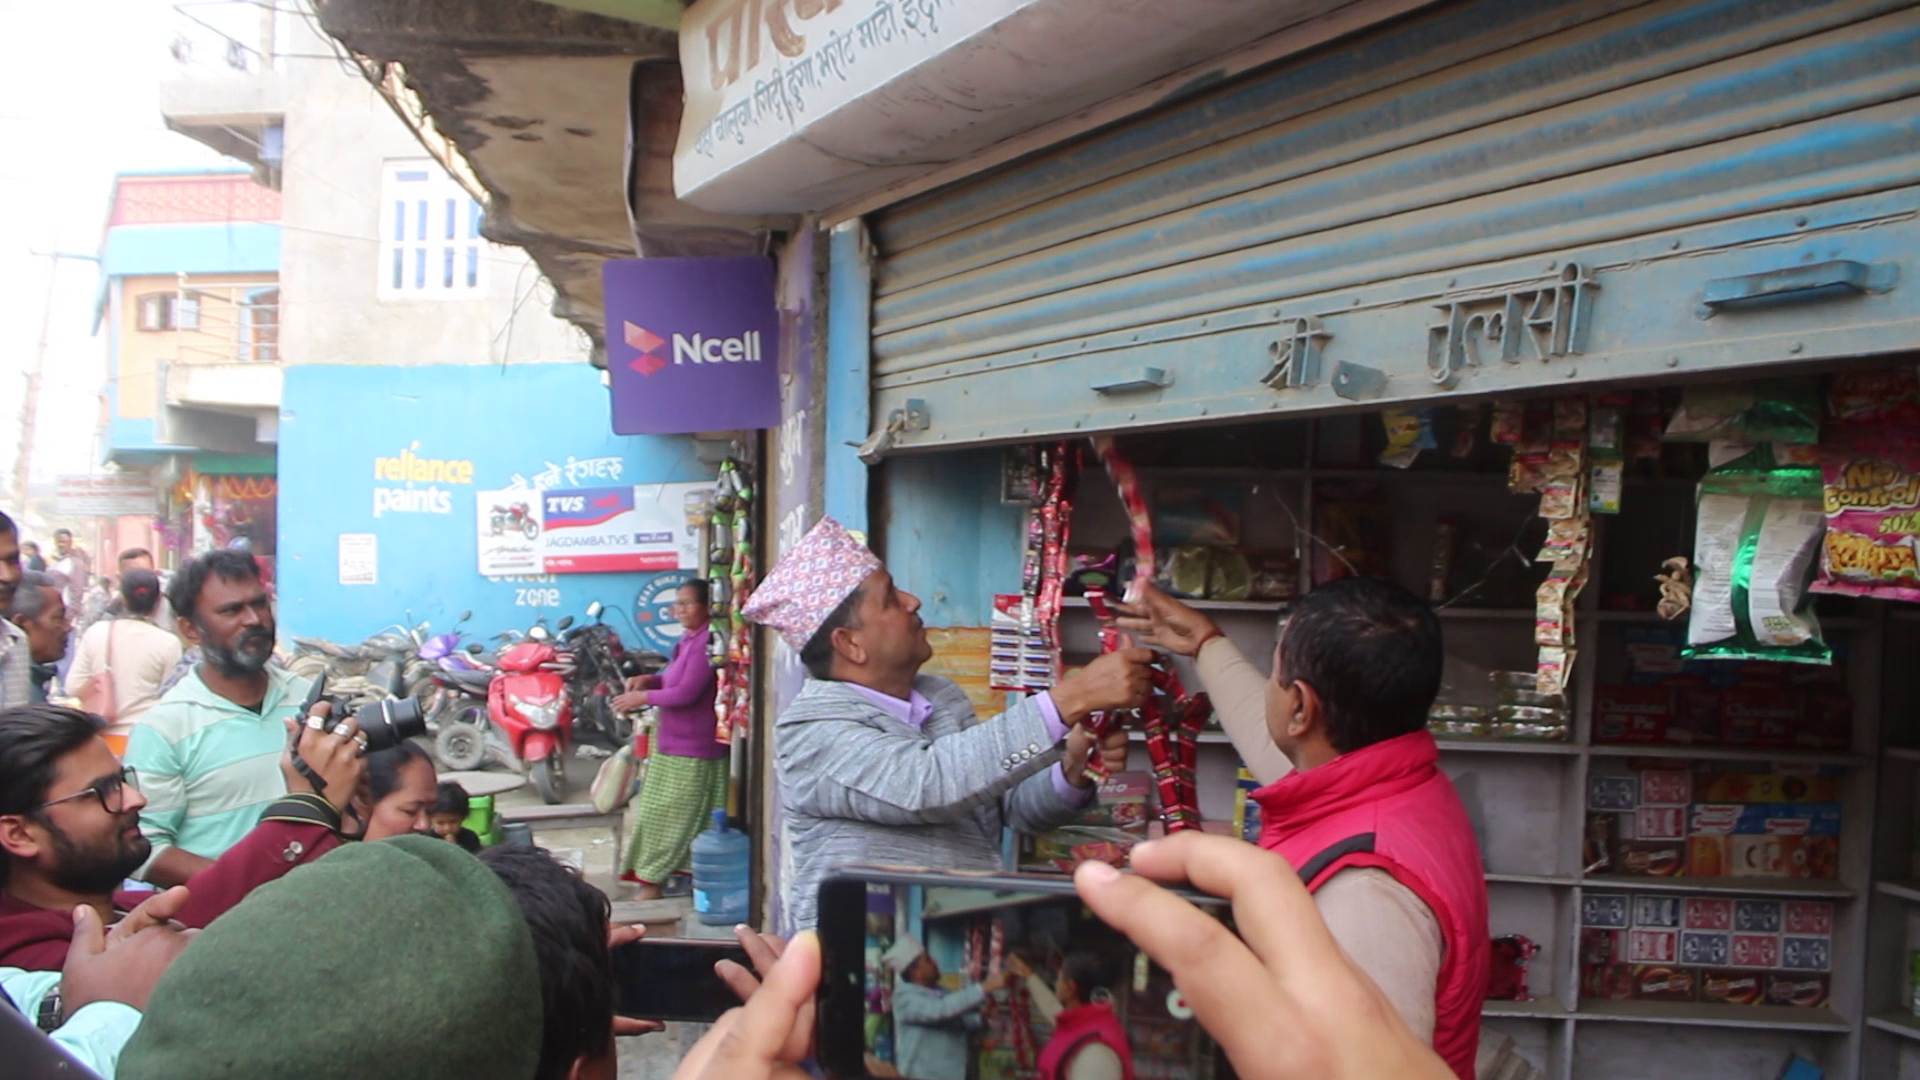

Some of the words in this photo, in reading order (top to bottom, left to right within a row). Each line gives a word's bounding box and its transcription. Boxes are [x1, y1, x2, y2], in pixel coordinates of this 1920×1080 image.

[1260, 315, 1335, 389] श्री
[1426, 261, 1601, 391] तुलसी
[672, 330, 761, 365] Ncell
[374, 439, 474, 485] reliance
[1845, 462, 1897, 489] No
[372, 480, 453, 518] paints
[546, 495, 585, 512] TVS
[1823, 475, 1920, 515] Control
[1878, 513, 1917, 535] 50%
[514, 587, 561, 608] zone
